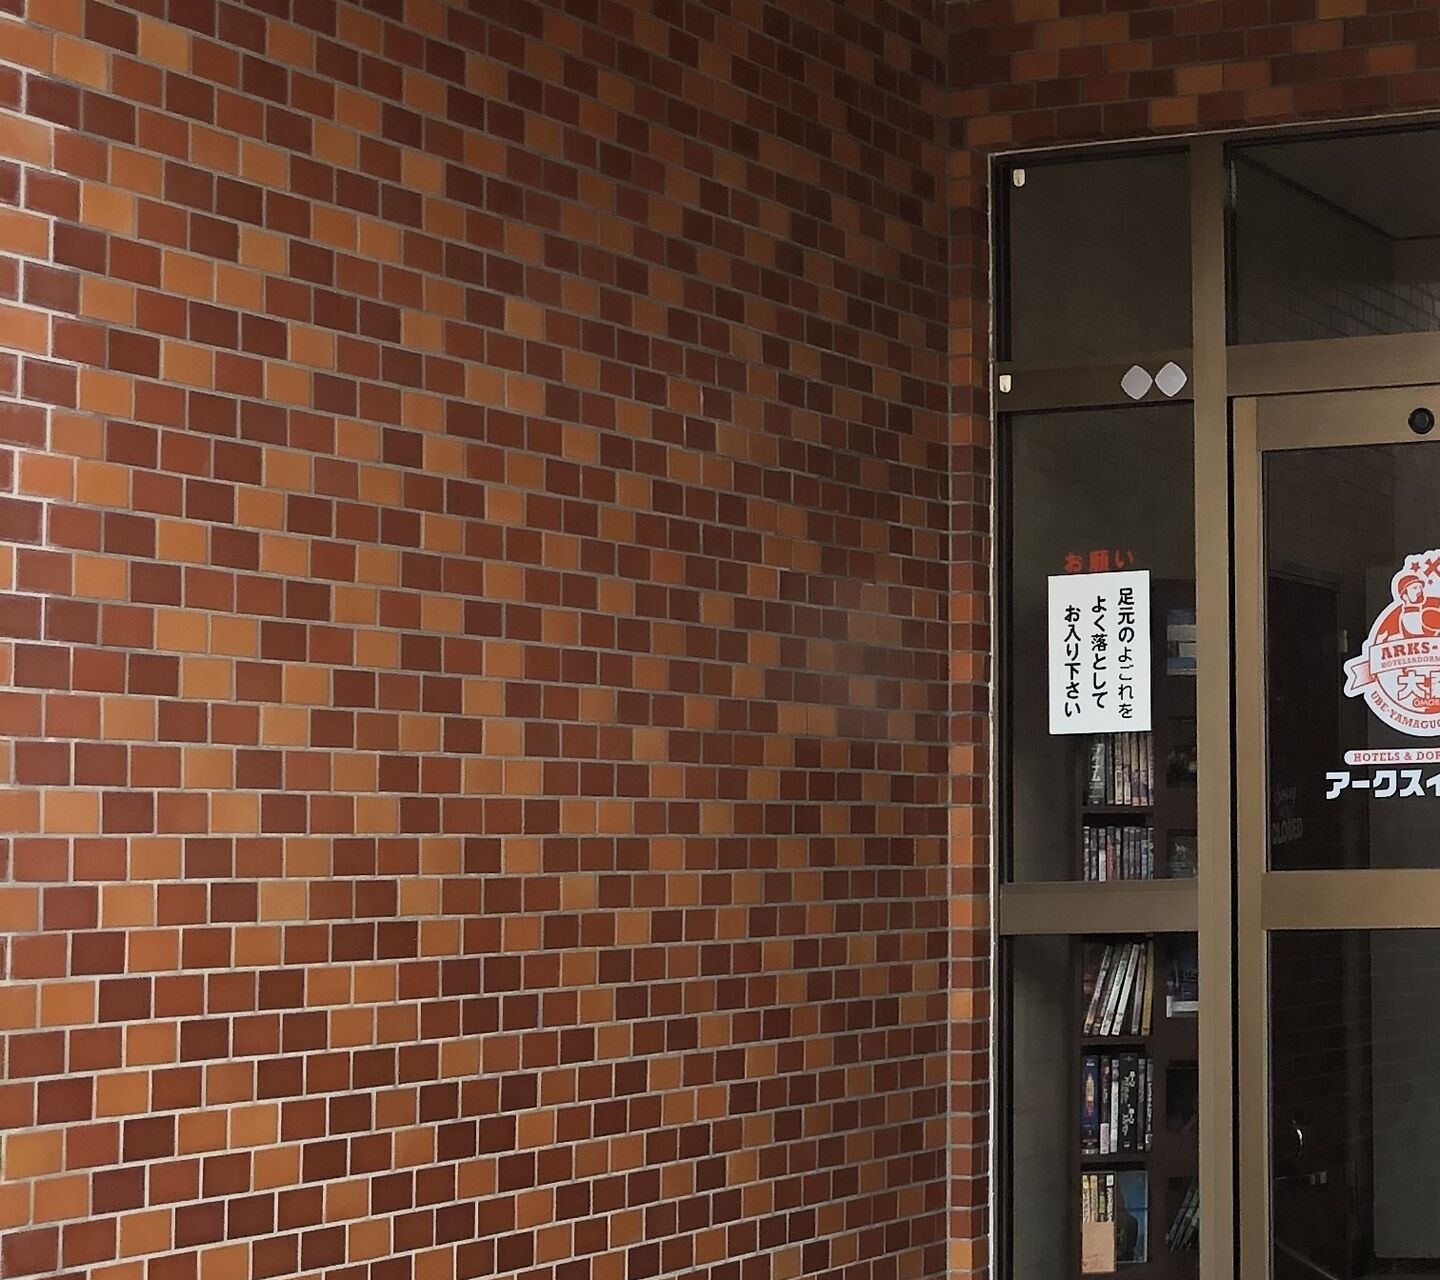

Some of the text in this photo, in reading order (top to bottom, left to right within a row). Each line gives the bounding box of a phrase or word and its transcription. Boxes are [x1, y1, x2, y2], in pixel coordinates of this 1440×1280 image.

[1064, 549, 1135, 572] お願い
[1063, 604, 1081, 718] お入り下さい
[1091, 595, 1108, 709] よく落として
[1117, 587, 1135, 719] 足元のよごれを
[1353, 751, 1400, 763] HOTELS
[1403, 751, 1411, 761] &
